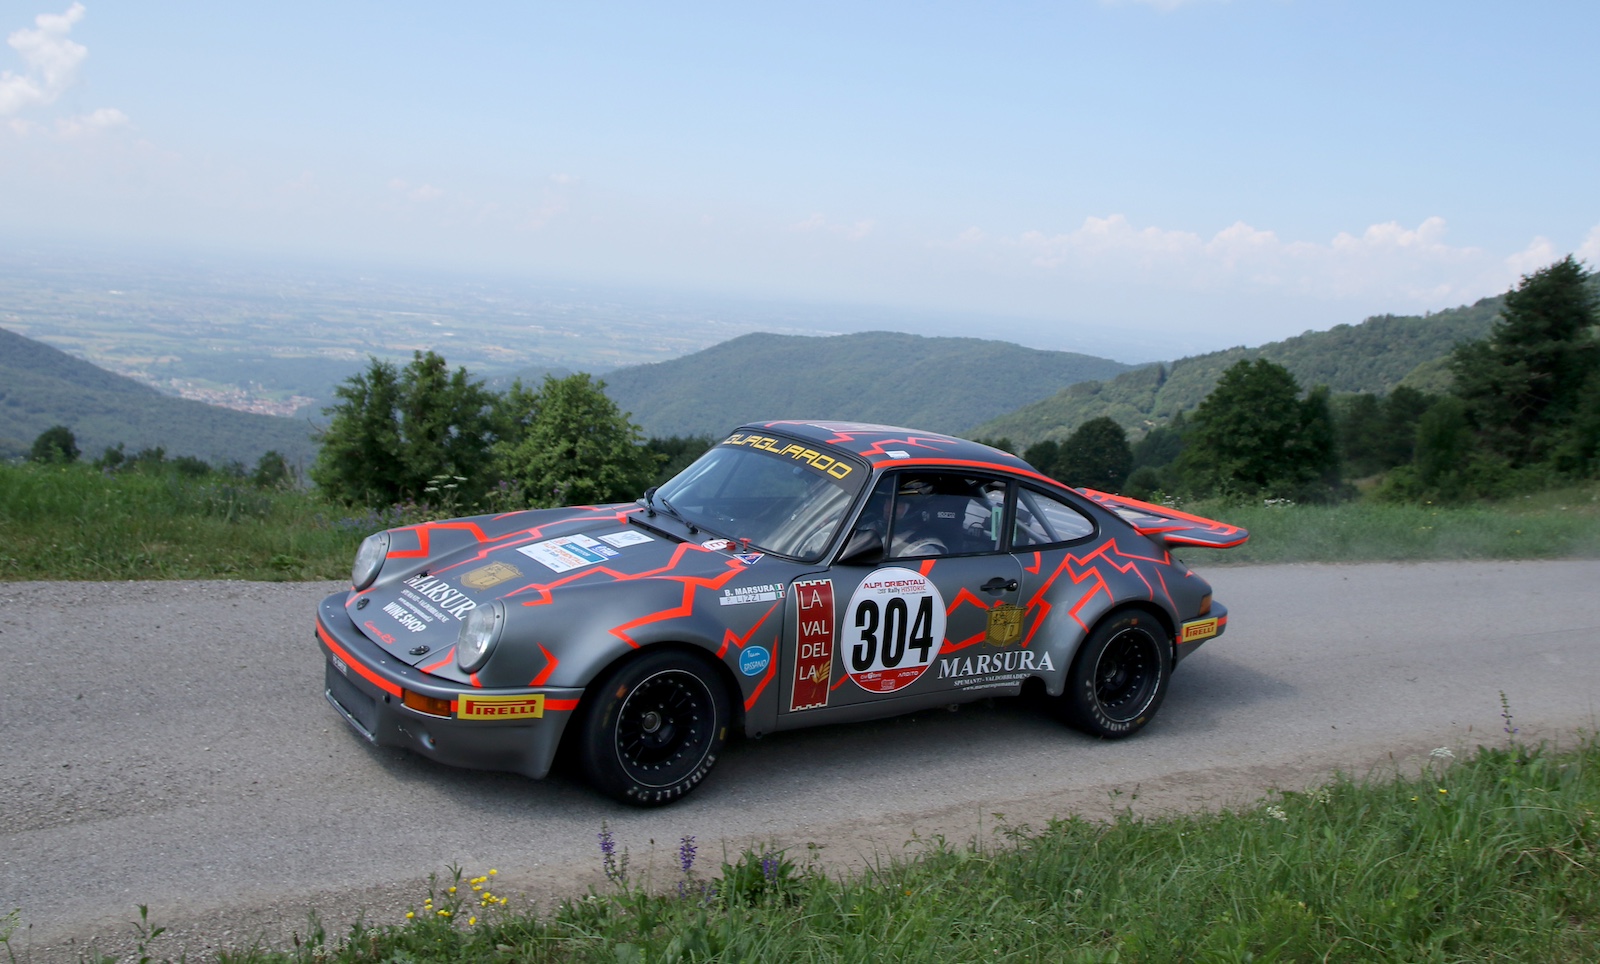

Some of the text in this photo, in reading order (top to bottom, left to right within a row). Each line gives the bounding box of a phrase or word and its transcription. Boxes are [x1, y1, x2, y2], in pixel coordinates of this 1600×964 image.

[724, 584, 775, 597] B. MARSURA
[884, 579, 925, 588] ORIENTALI
[402, 573, 477, 621] MARSUR
[799, 589, 823, 610] LA
[382, 601, 427, 632] WINE SHOP
[802, 620, 829, 637] VAL
[852, 596, 933, 671] 304
[1185, 621, 1215, 638] PIRELLI
[801, 642, 829, 659] DEL
[799, 664, 818, 681] LA
[937, 650, 1056, 679] MARSURA
[465, 699, 536, 715] PIRELLI
